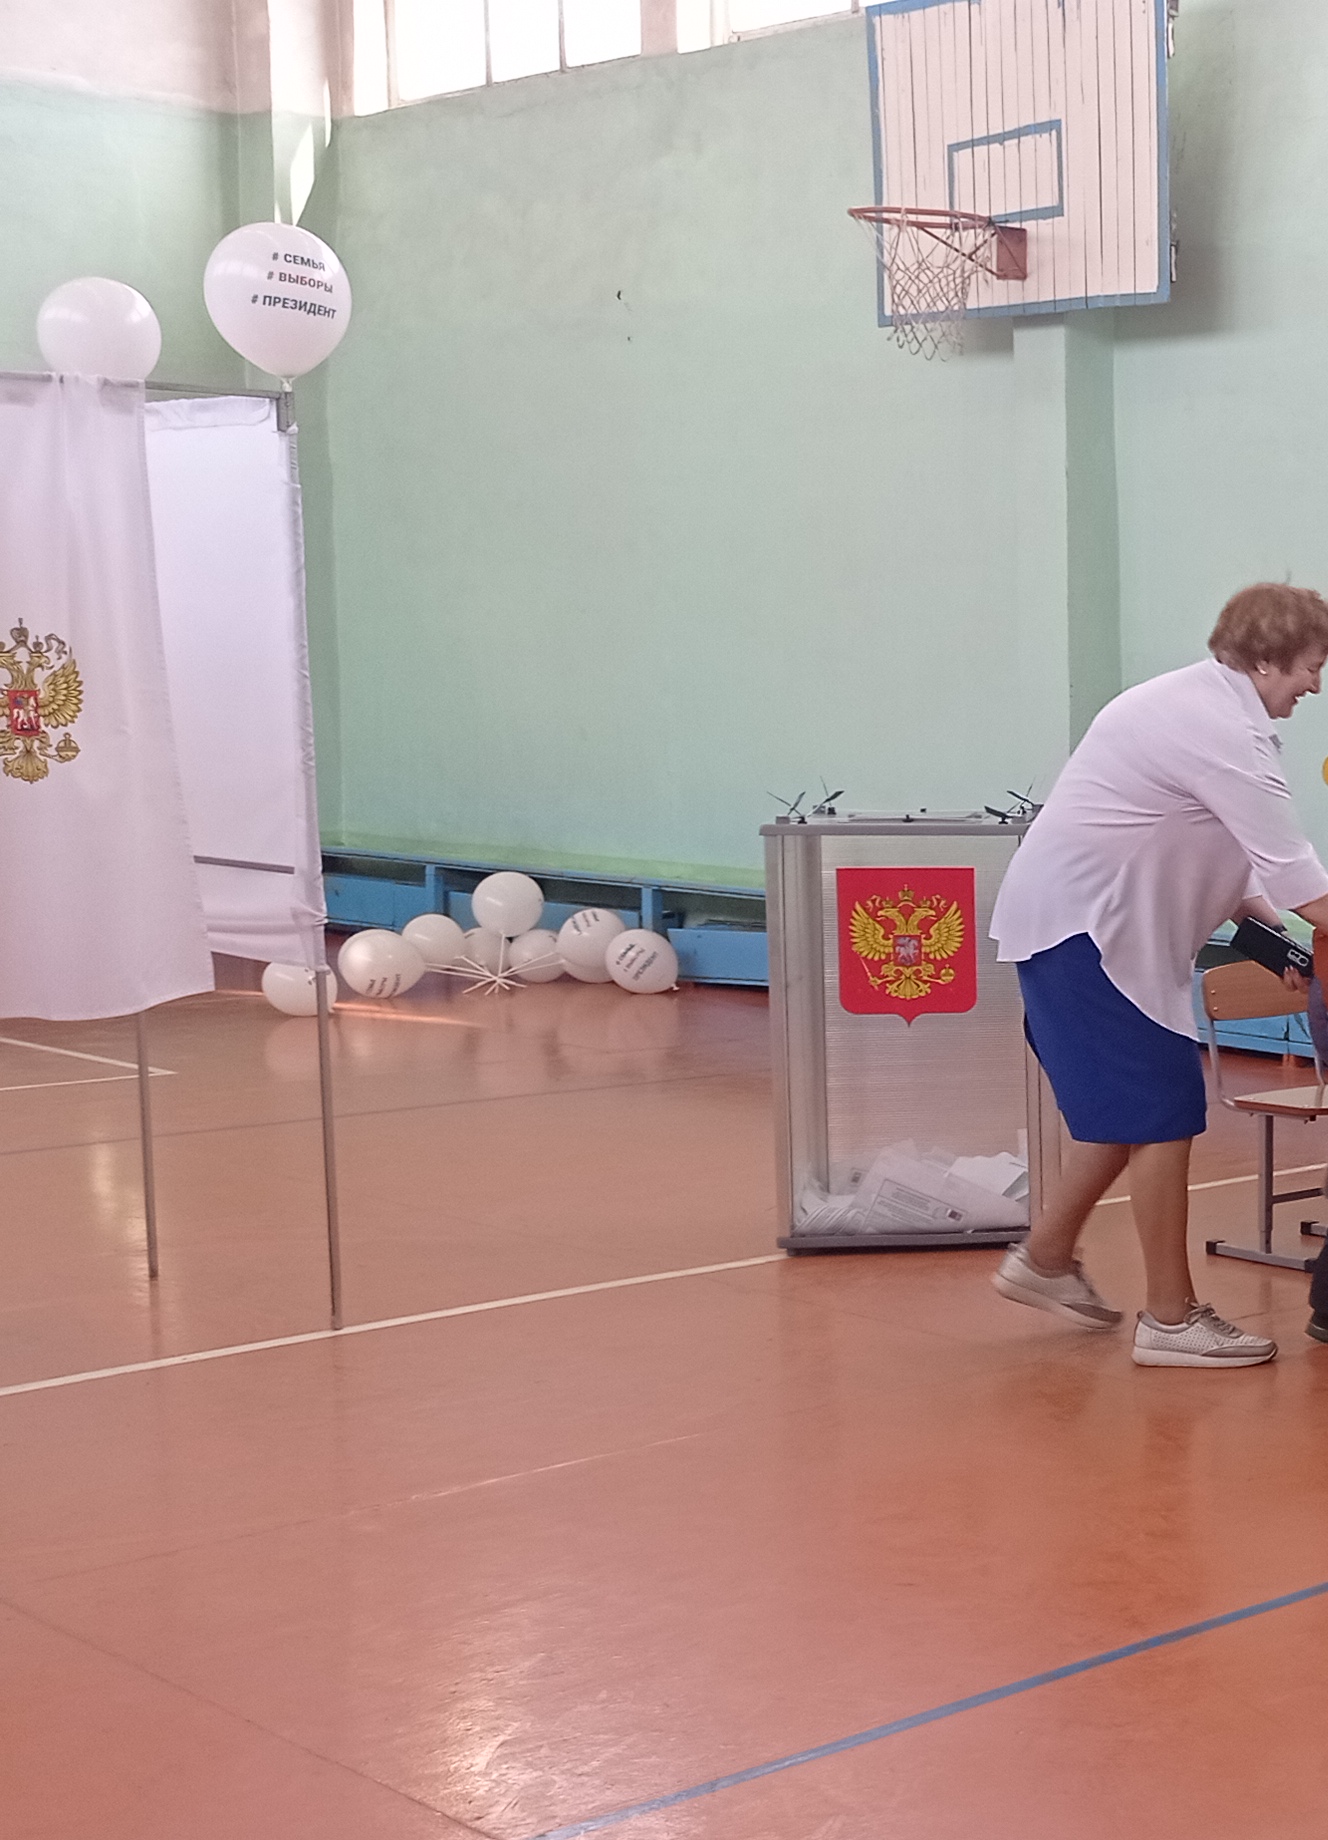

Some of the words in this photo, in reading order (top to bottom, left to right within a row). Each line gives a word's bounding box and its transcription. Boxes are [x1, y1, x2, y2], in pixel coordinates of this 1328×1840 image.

[283, 253, 326, 272] СЕМЬЯ
[279, 271, 333, 293] ВЫБОРЫ
[262, 295, 337, 319] ПРЕЗИДЕНТ
